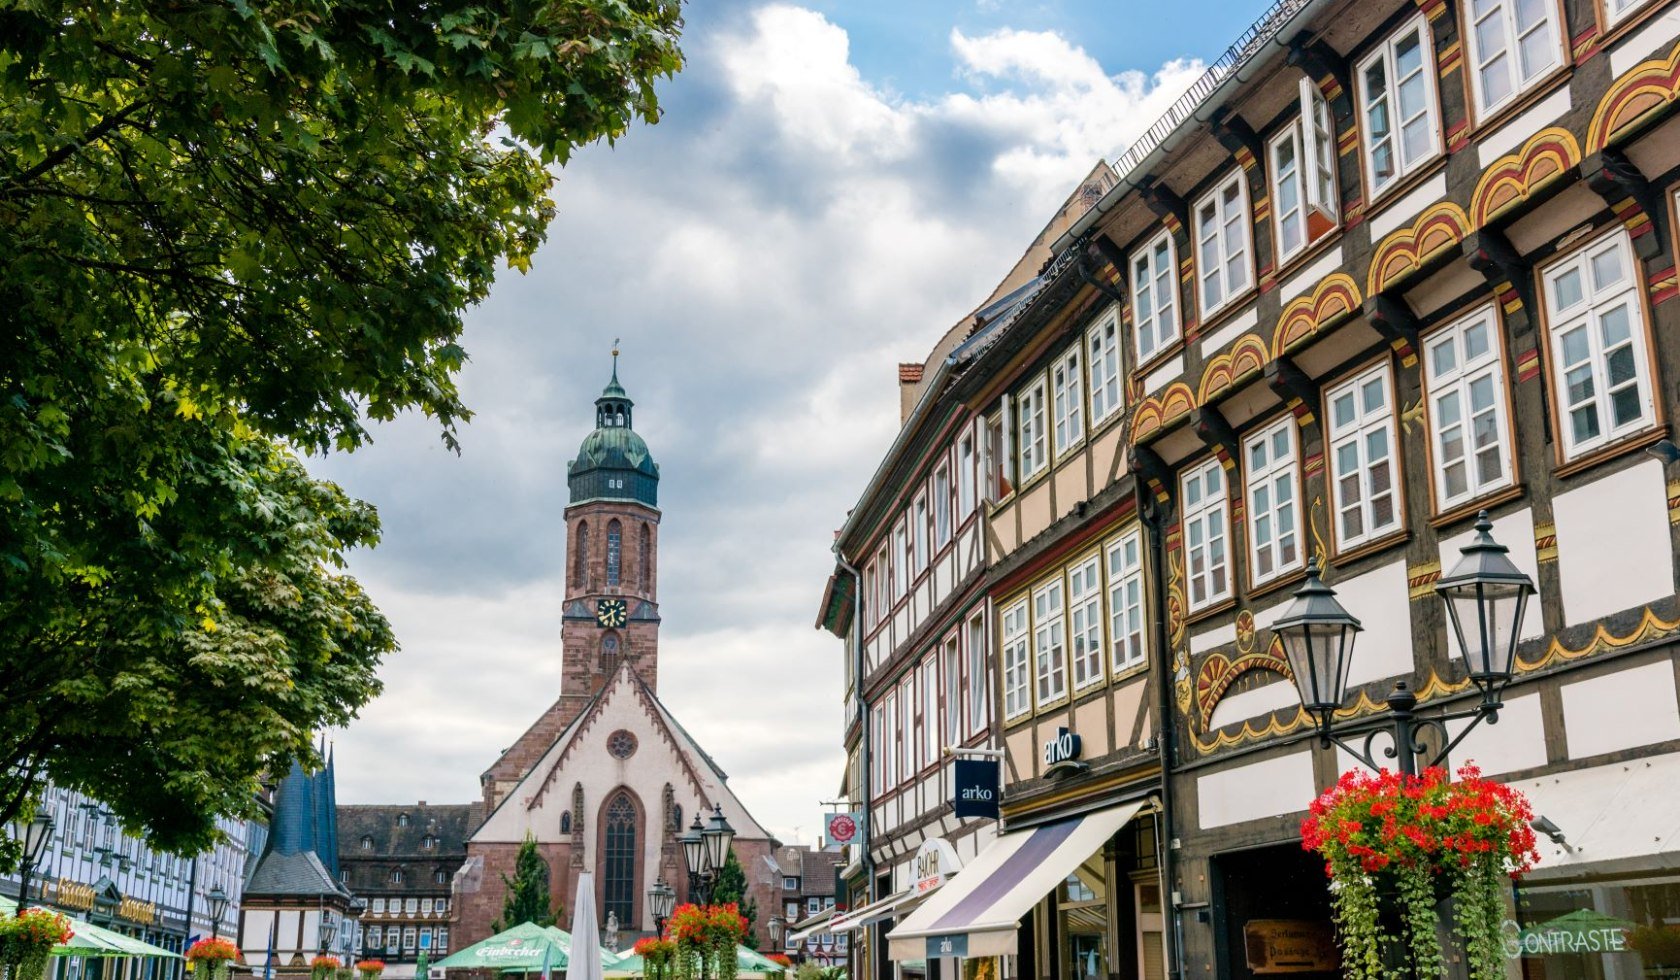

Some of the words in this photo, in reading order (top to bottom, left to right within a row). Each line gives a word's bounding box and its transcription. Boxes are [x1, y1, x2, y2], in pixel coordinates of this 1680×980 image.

[1044, 728, 1073, 765] arko
[962, 785, 993, 800] arko
[1500, 919, 1625, 959] CONTRASTE
